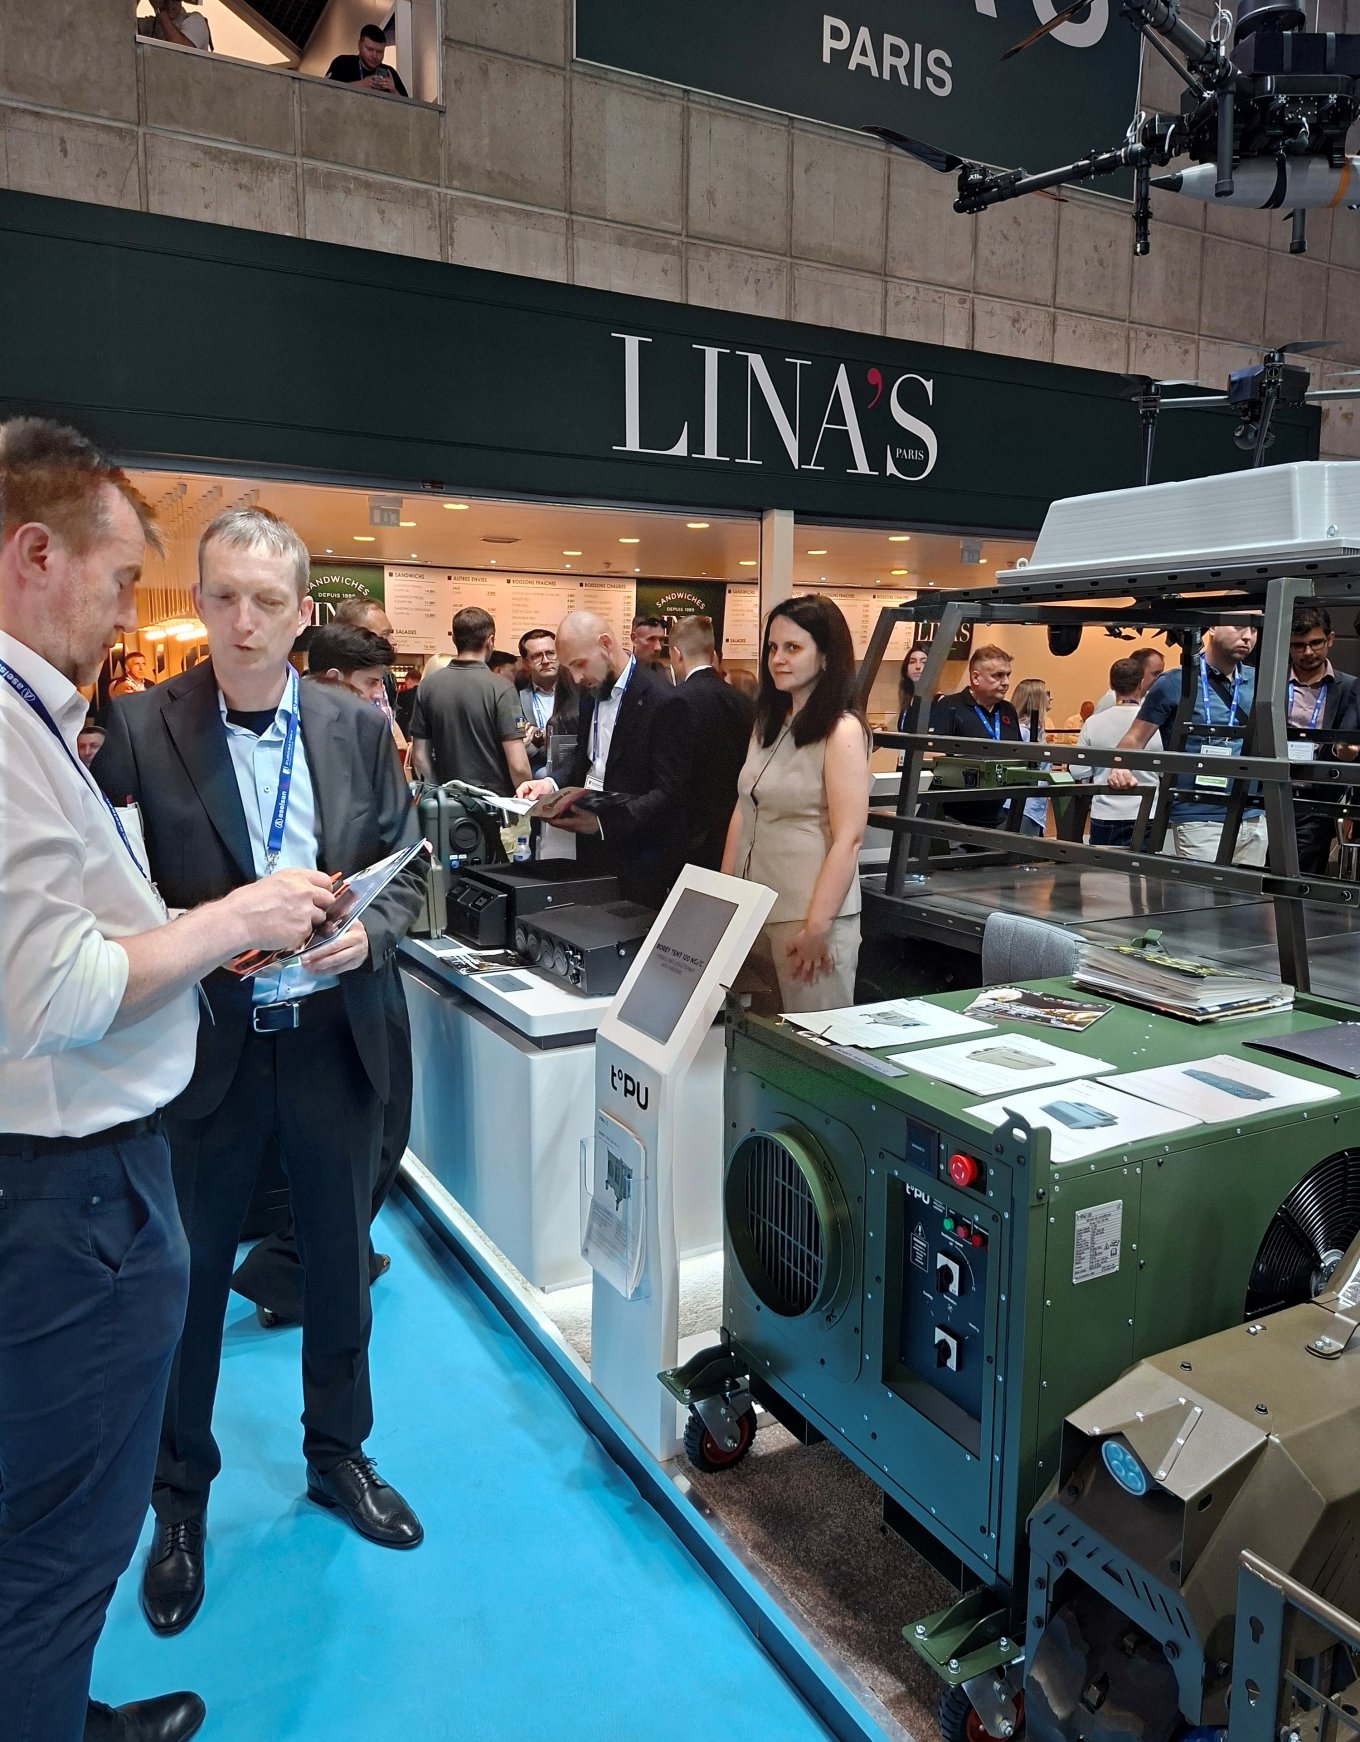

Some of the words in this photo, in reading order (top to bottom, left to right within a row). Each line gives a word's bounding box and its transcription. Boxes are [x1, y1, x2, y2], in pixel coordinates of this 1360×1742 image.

[822, 14, 953, 97] PARIS
[610, 332, 938, 481] LINA'S
[895, 447, 924, 461] PARIS
[655, 592, 706, 610] SANDWICHES
[0, 662, 25, 690] asels
[278, 790, 287, 818] aselsan
[671, 948, 683, 958] TENT
